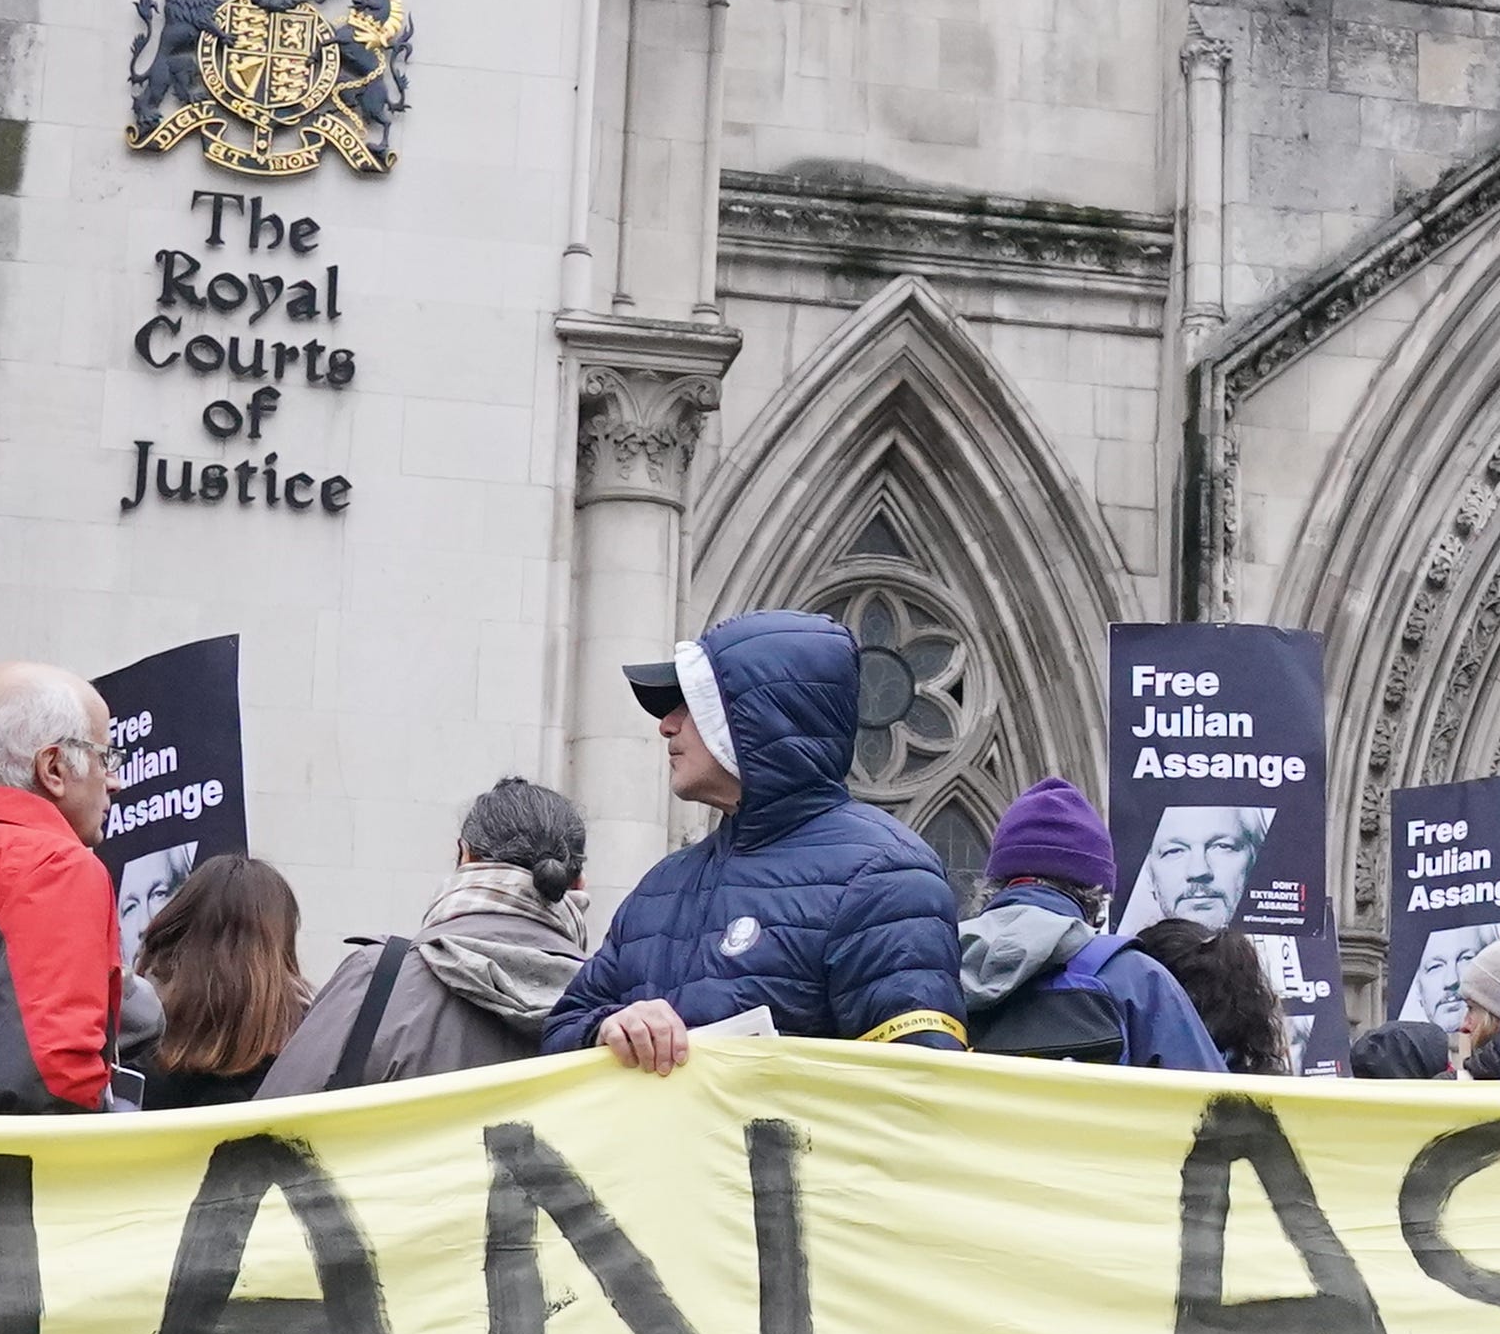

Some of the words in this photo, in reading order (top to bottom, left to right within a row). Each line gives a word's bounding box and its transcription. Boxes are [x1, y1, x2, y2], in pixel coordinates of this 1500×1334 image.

[313, 115, 373, 169] DROIT
[191, 190, 320, 253] The
[155, 249, 342, 325] Royal
[135, 315, 357, 386] Courts
[202, 385, 281, 439] of
[120, 440, 353, 512] Justice
[1131, 665, 1220, 697] Free
[1131, 703, 1254, 738] Julian
[117, 746, 178, 790] ulian
[1131, 746, 1307, 788] Assange
[105, 779, 224, 840] Assange
[1407, 819, 1469, 847] Free
[1407, 846, 1492, 879] Julian
